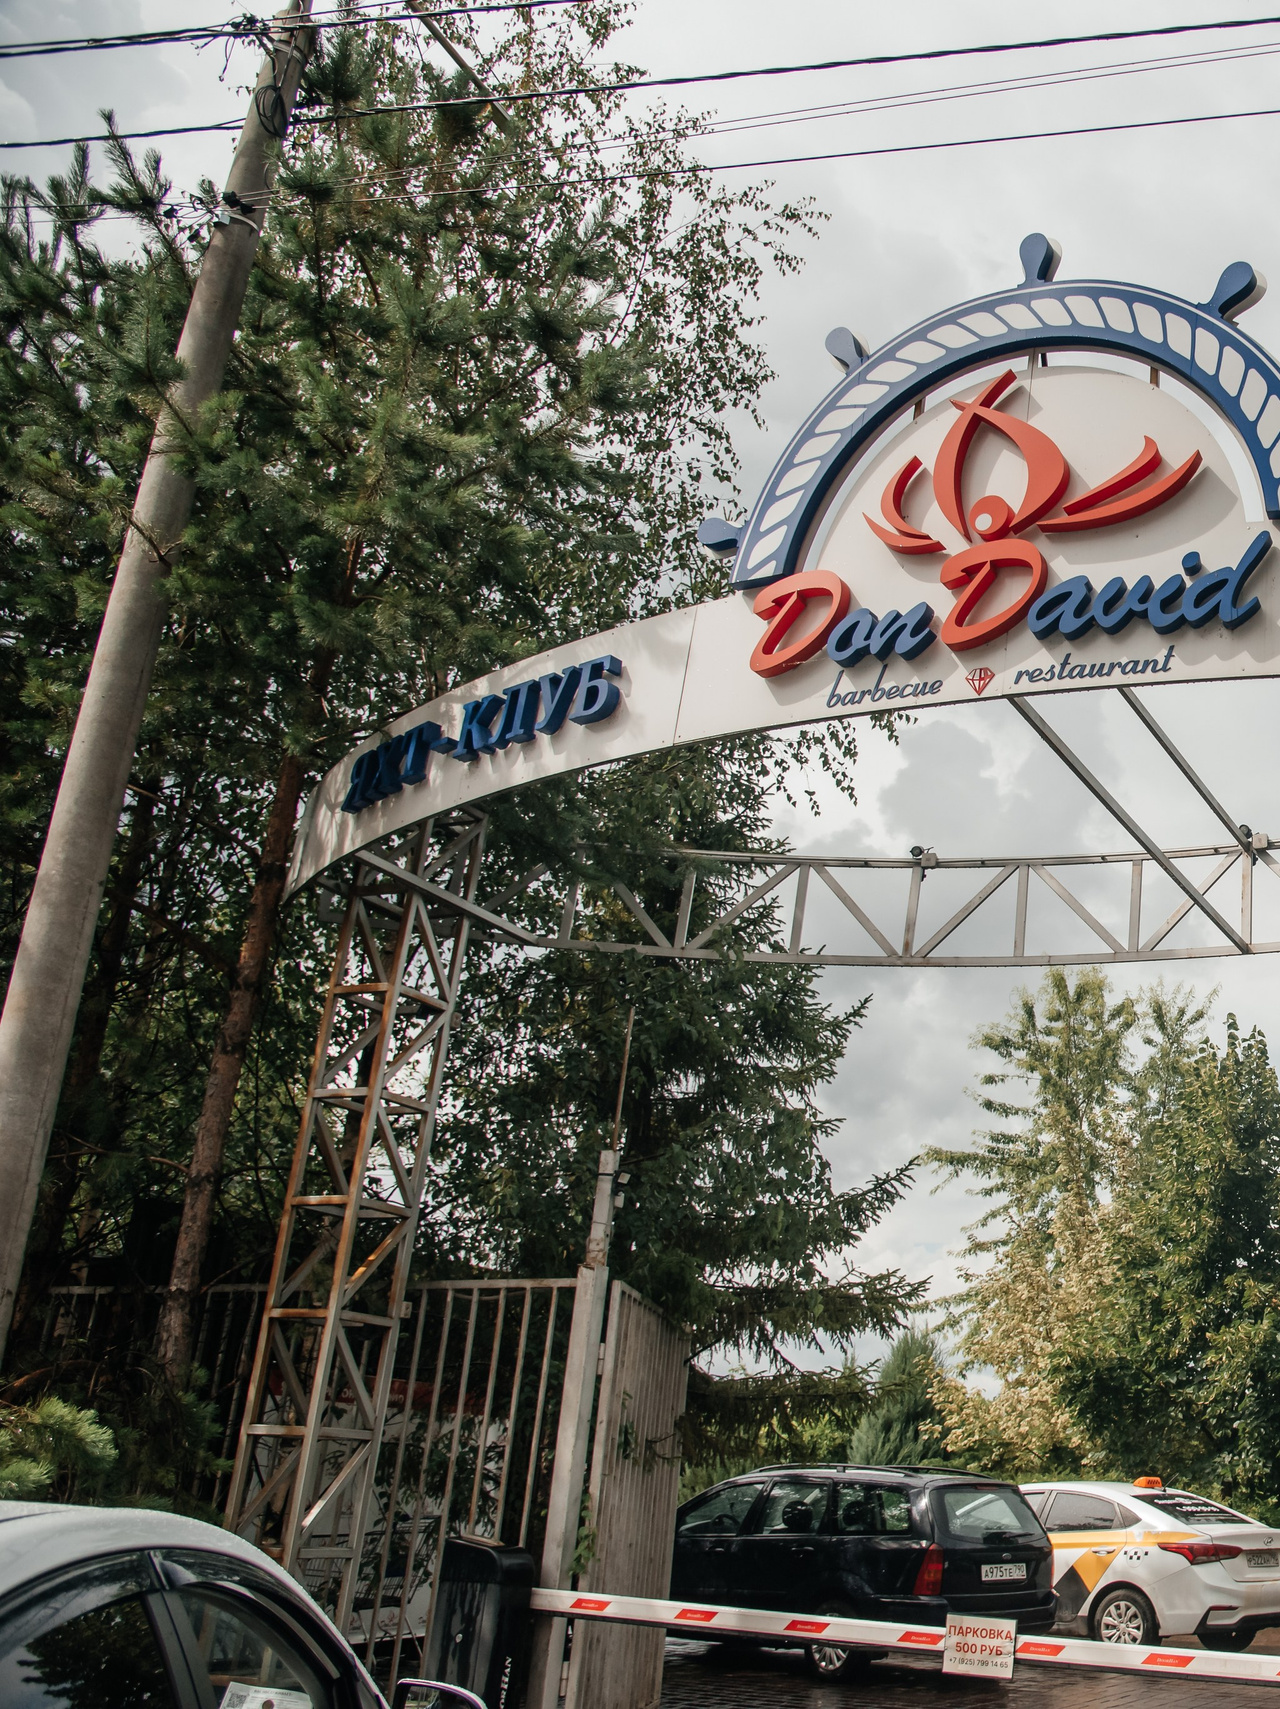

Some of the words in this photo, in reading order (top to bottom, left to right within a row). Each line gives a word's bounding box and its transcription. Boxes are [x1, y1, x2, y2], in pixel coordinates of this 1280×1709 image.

[750, 570, 937, 678] Don
[940, 530, 1273, 652] David
[826, 664, 943, 708] barbecue
[1013, 645, 1175, 684] restaurant
[949, 1624, 1013, 1641] ПАРКОВКА
[955, 1642, 977, 1654] 500
[980, 1644, 1003, 1656] РУБ
